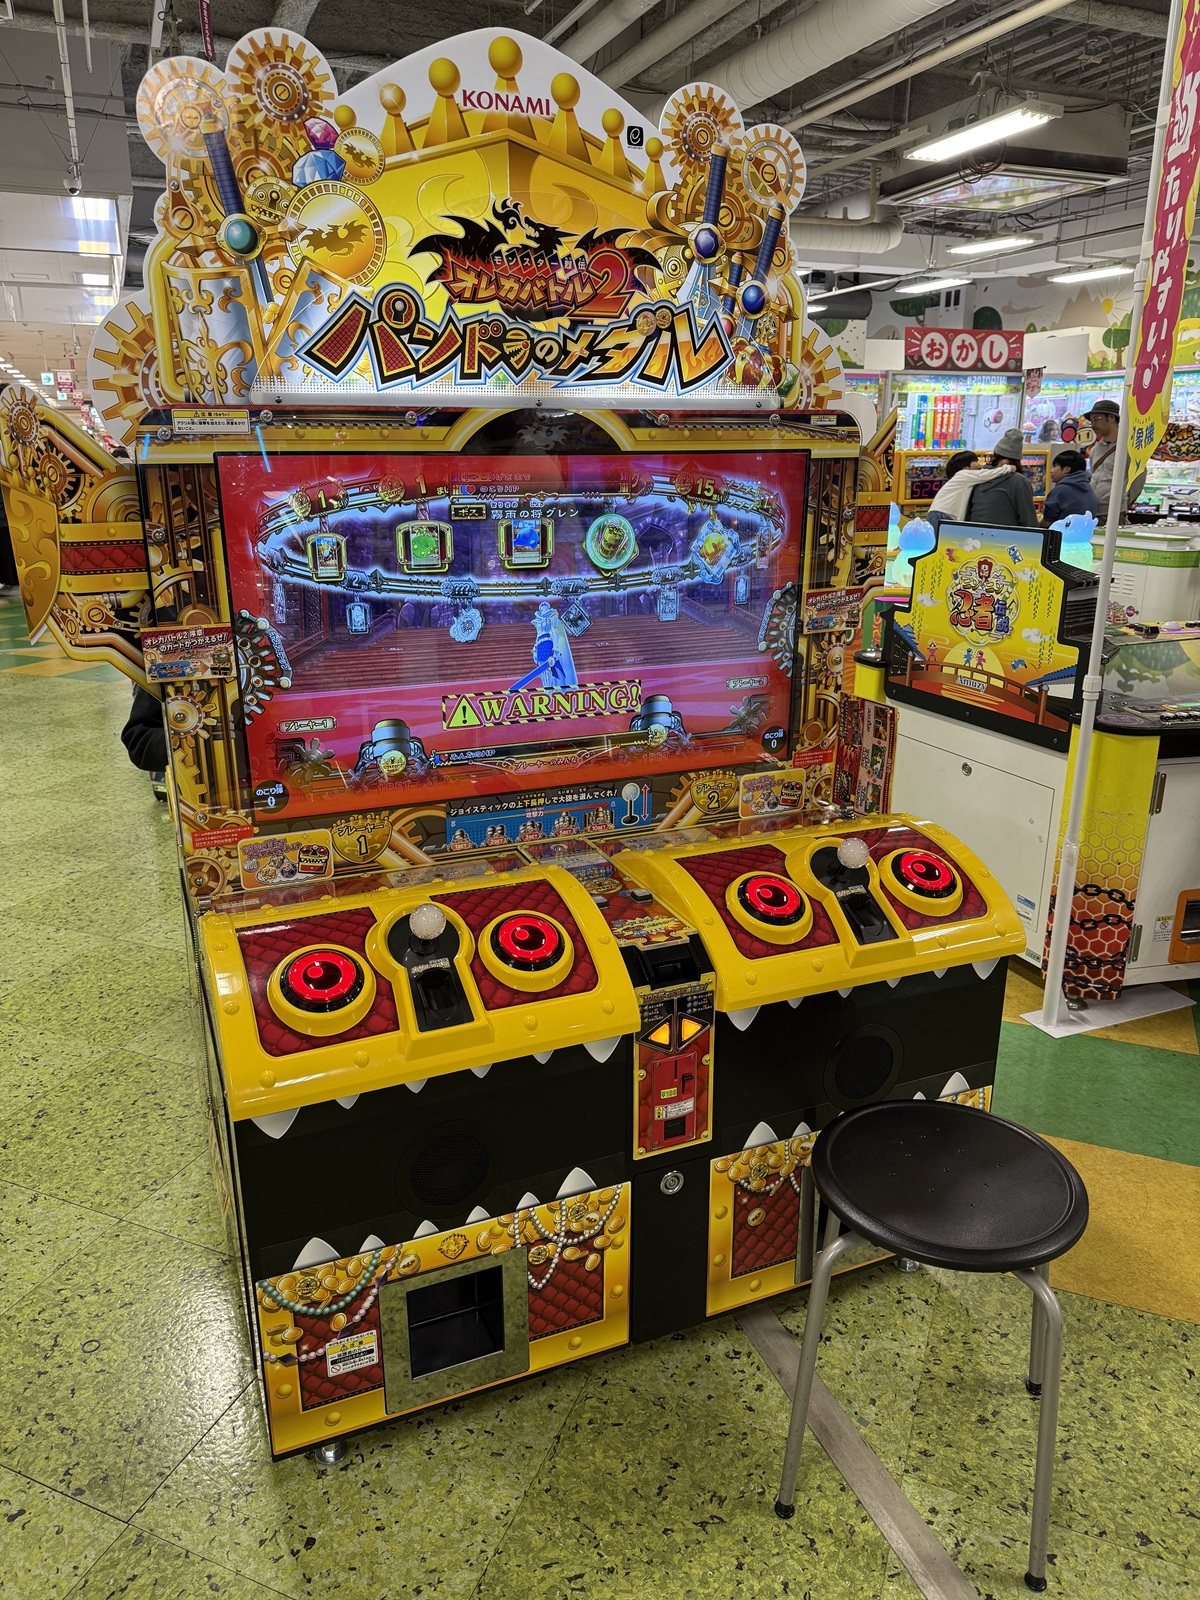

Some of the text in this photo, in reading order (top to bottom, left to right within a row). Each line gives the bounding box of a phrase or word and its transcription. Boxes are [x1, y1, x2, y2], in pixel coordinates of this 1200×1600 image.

[462, 89, 550, 115] KONAMI
[494, 255, 586, 270] モンスター烈伝
[450, 250, 632, 317] オレカバトル2
[308, 291, 728, 386] パンドラのメダル
[926, 339, 1003, 363] おかし
[415, 474, 426, 494] 1
[480, 485, 519, 493] のこりHP
[696, 478, 715, 498] 15
[318, 489, 327, 509] 1
[949, 588, 995, 632] 忍者
[993, 598, 1011, 634] 伝説
[956, 675, 988, 693] Amuzy
[479, 684, 641, 721] WARNING!
[771, 739, 777, 749] 0
[696, 781, 732, 793] プレーヤー
[268, 796, 276, 807] 0
[707, 790, 720, 810] 2
[337, 823, 385, 837] プレーヤー
[357, 835, 368, 857] 1
